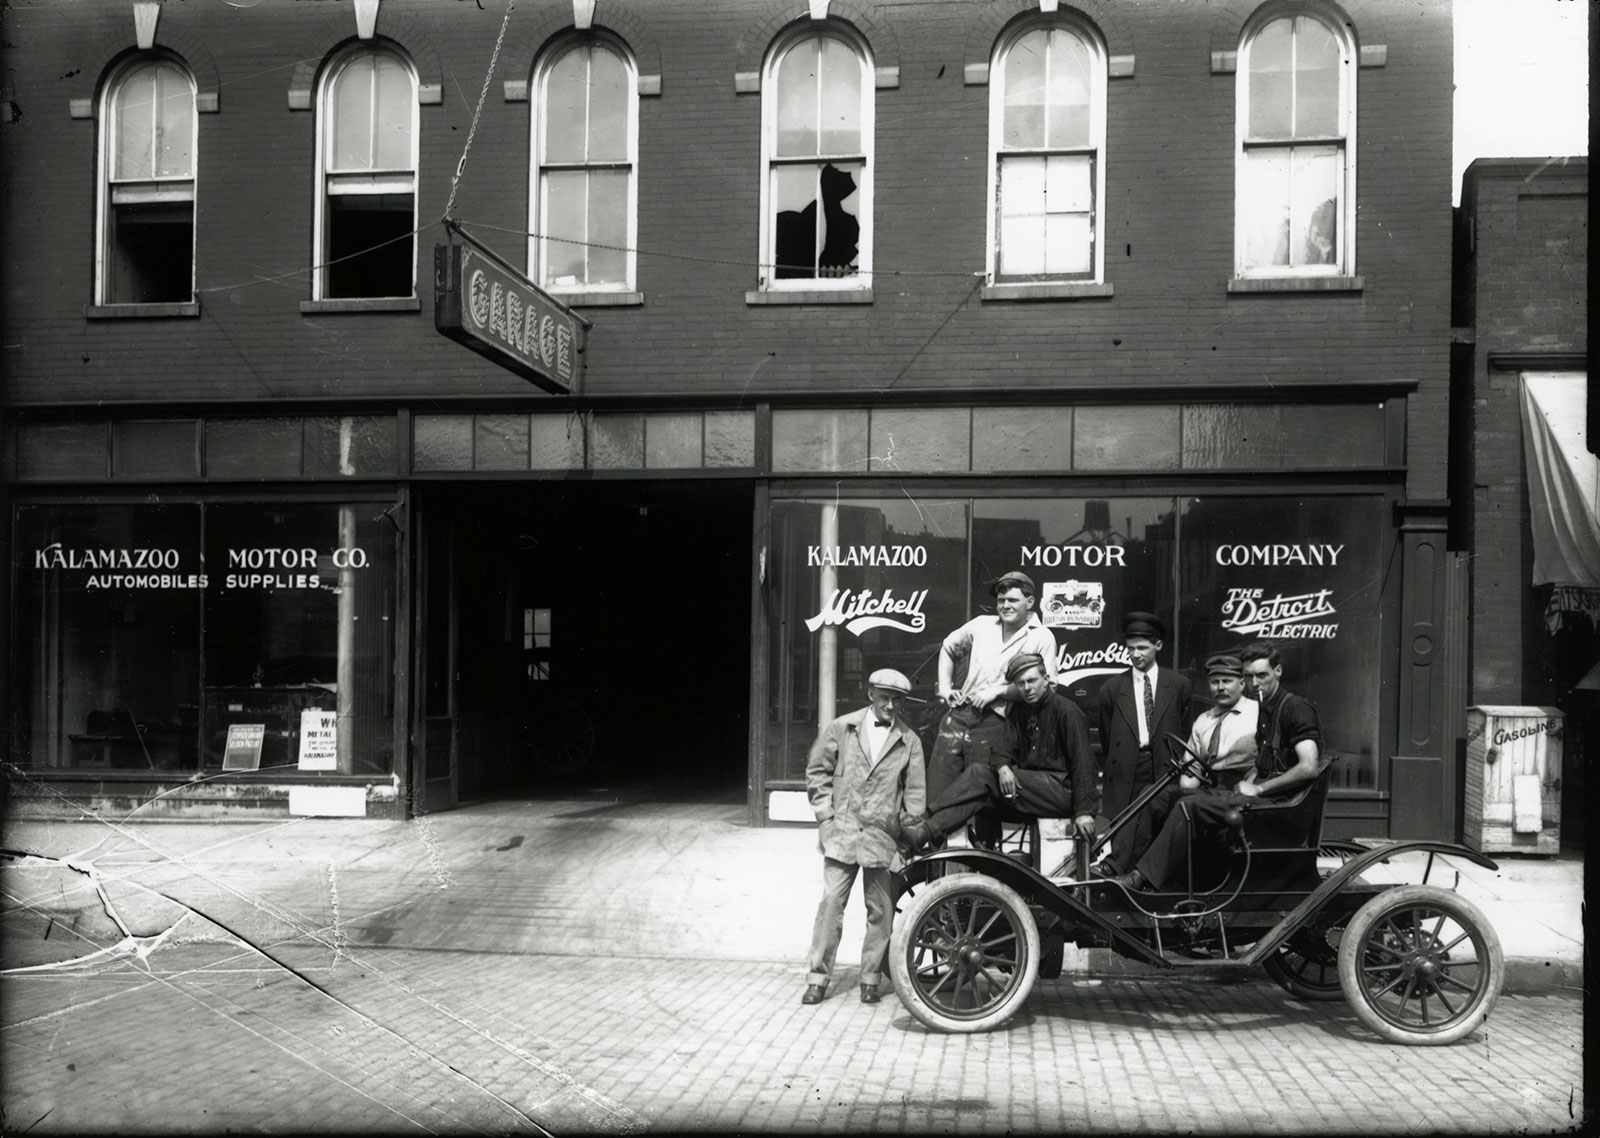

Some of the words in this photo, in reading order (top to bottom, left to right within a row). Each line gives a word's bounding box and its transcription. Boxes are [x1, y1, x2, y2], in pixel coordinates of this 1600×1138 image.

[469, 269, 571, 379] GARAGE
[35, 543, 180, 569] KALAMAZOO
[228, 548, 318, 569] MOTOR
[332, 548, 370, 569] CO.
[807, 545, 928, 567] KALAMAZOO
[1021, 545, 1127, 567] MOTOR
[1215, 544, 1345, 567] COMPANY
[86, 575, 209, 589] AUTOMOBILES
[226, 574, 320, 589] SUPPLIES
[1227, 588, 1264, 600] THE
[804, 588, 929, 636] Mitchell
[1221, 589, 1336, 629] Detroit
[1257, 621, 1339, 639] ELECTRIC
[1493, 718, 1558, 746] GASOLINE
